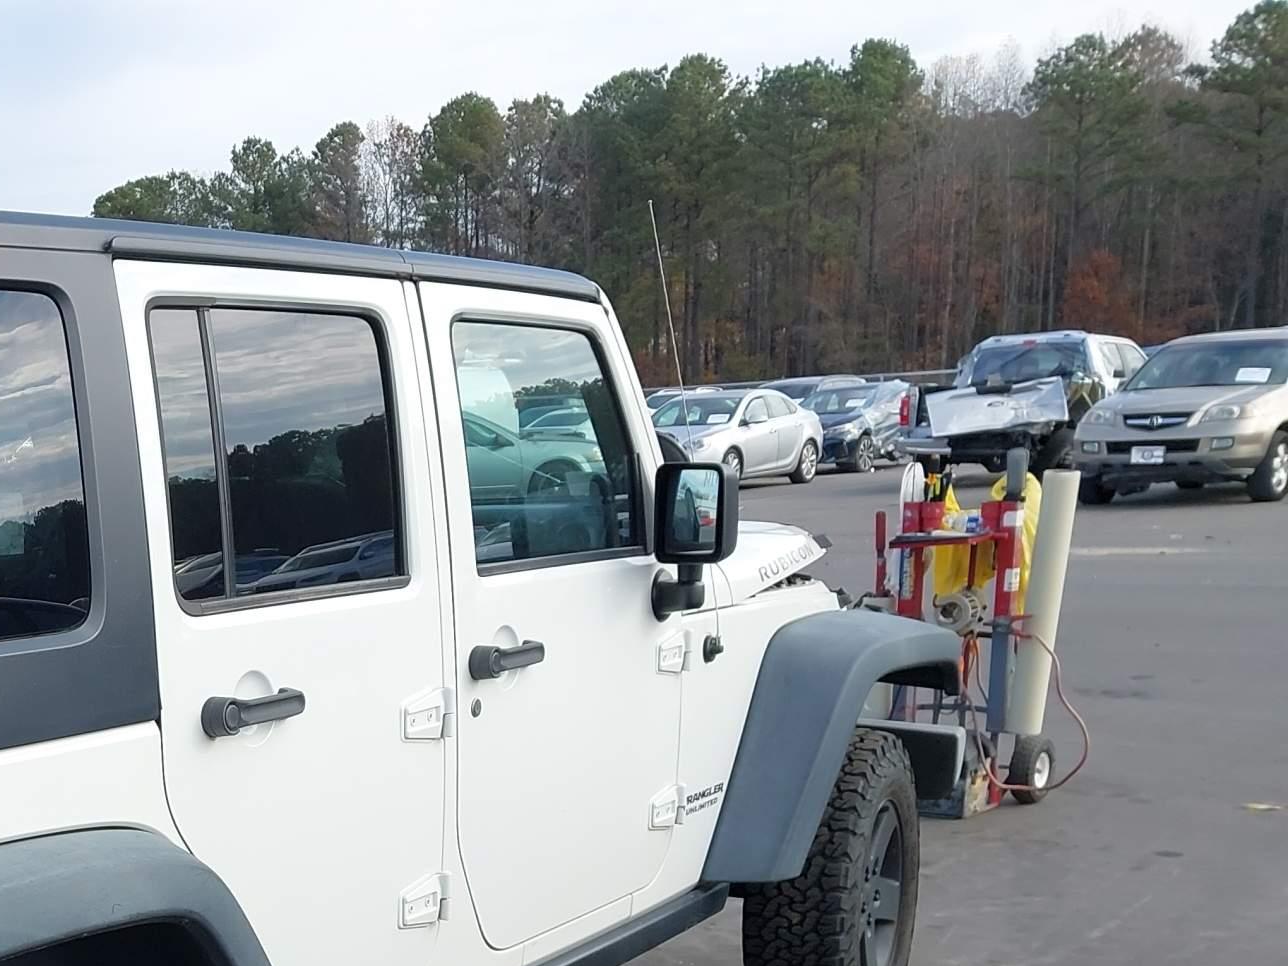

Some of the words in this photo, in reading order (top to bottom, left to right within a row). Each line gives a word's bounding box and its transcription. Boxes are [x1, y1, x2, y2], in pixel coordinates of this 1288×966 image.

[758, 543, 815, 582] RUBICON
[686, 782, 724, 805] RANGLER
[685, 797, 718, 816] UNLIMITED
